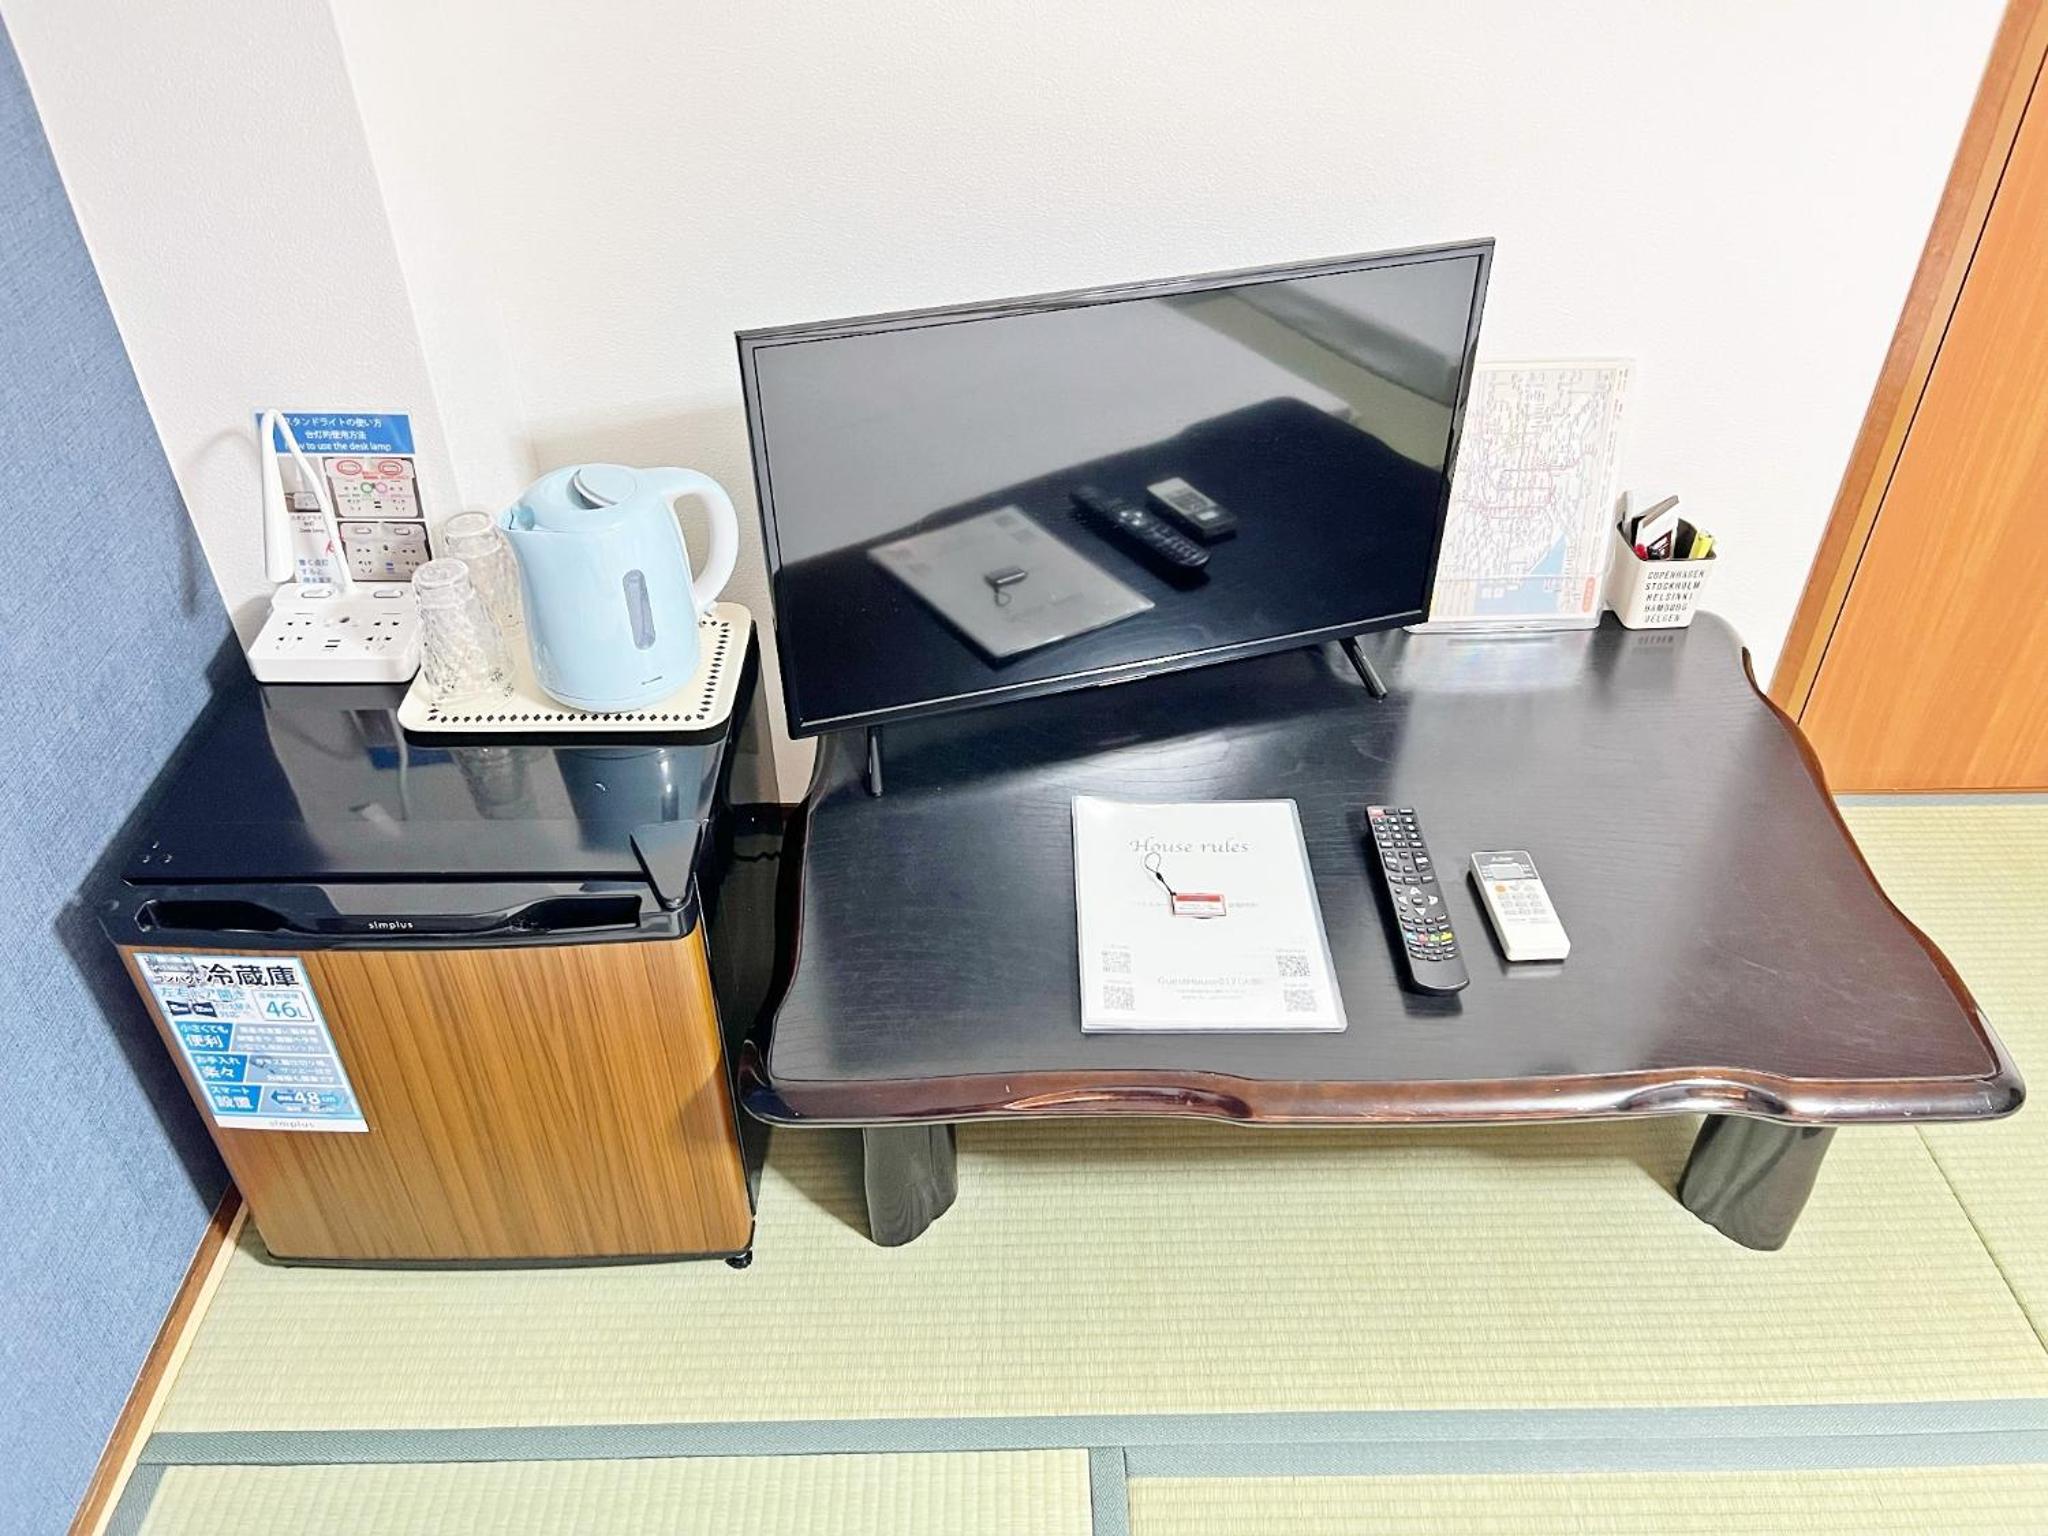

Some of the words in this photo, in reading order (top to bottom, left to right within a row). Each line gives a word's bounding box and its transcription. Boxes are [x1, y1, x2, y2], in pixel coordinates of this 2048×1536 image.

[334, 441, 348, 451] the
[349, 441, 368, 451] desk
[370, 442, 392, 452] lamp
[1647, 569, 1705, 580] COPENHAGEN
[1645, 581, 1701, 591] STOCKHOLM
[1646, 593, 1693, 602] HELSINKI
[1129, 836, 1192, 853] House
[1201, 836, 1250, 853] rules
[368, 920, 414, 930] simplus
[201, 963, 299, 986] 冷蔵庫
[266, 1000, 307, 1018] 46L
[186, 1035, 224, 1048] 便利
